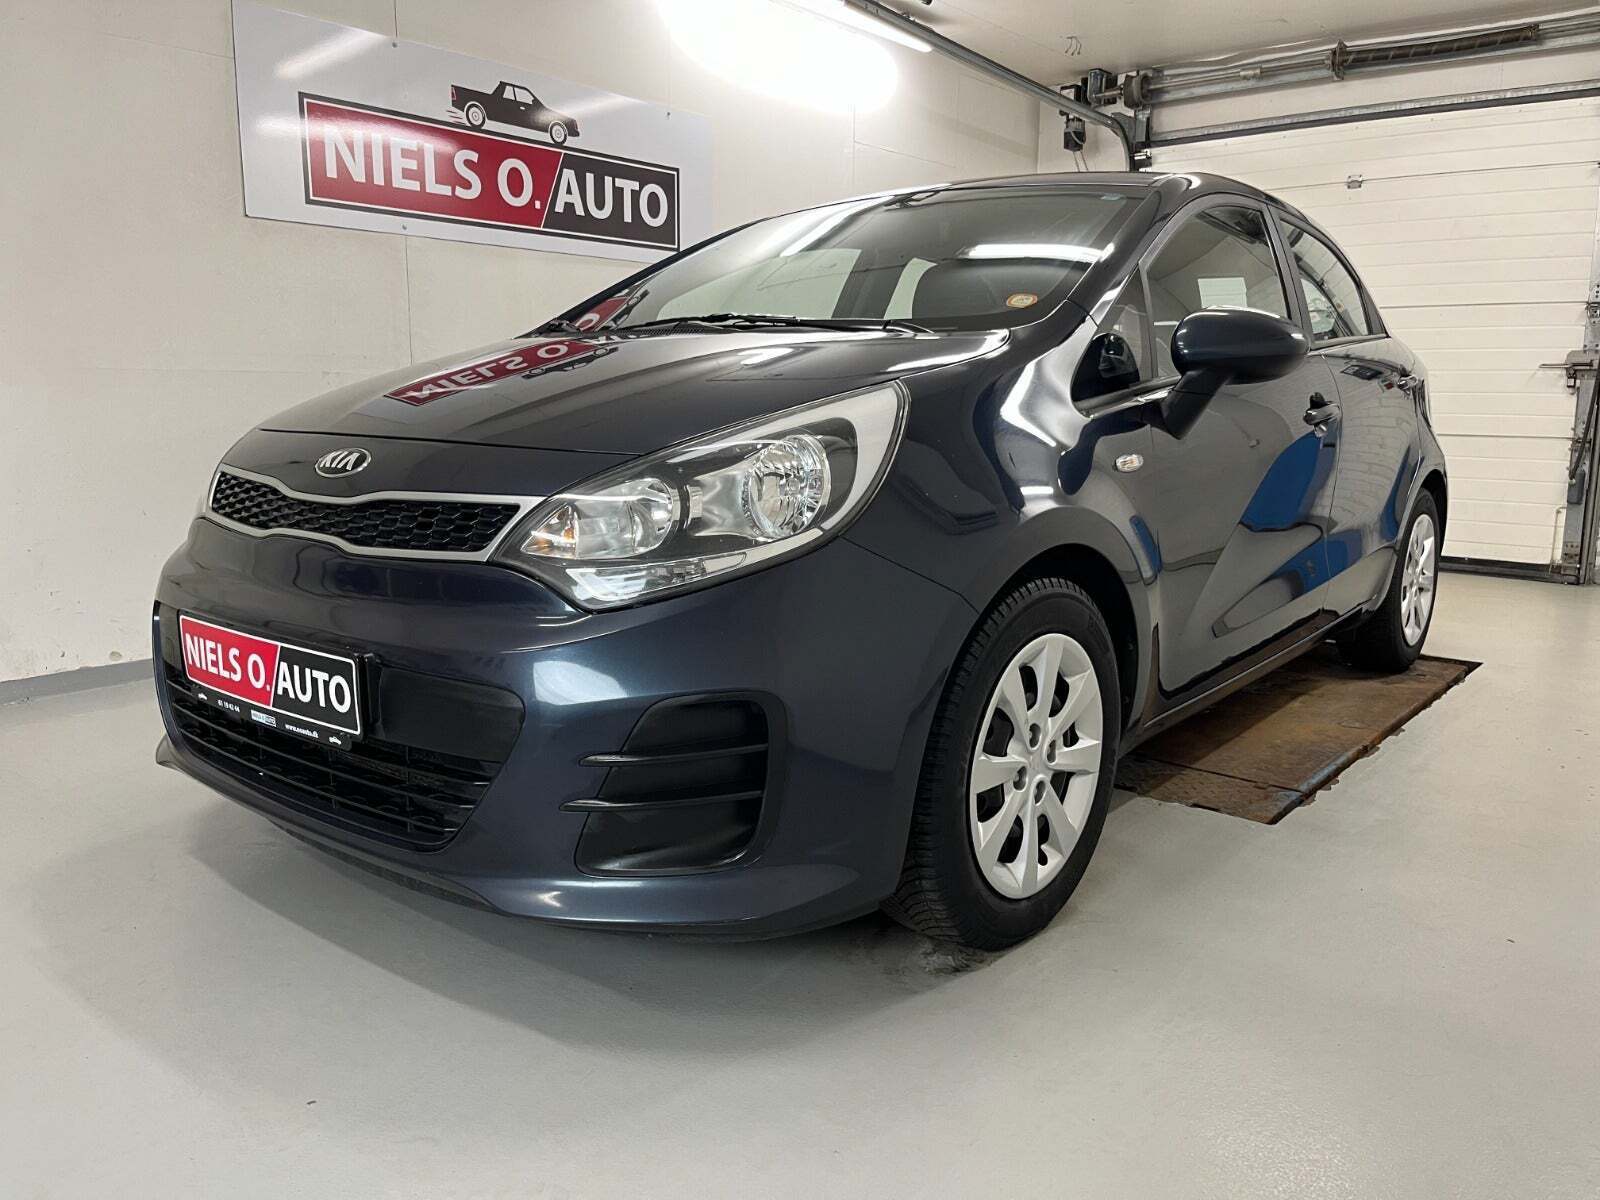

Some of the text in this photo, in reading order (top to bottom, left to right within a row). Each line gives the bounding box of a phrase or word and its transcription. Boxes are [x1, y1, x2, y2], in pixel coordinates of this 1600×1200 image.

[322, 126, 669, 228] NIELS O. AUTO
[319, 450, 360, 471] KIA
[185, 632, 352, 714] NIELS O. AUTO
